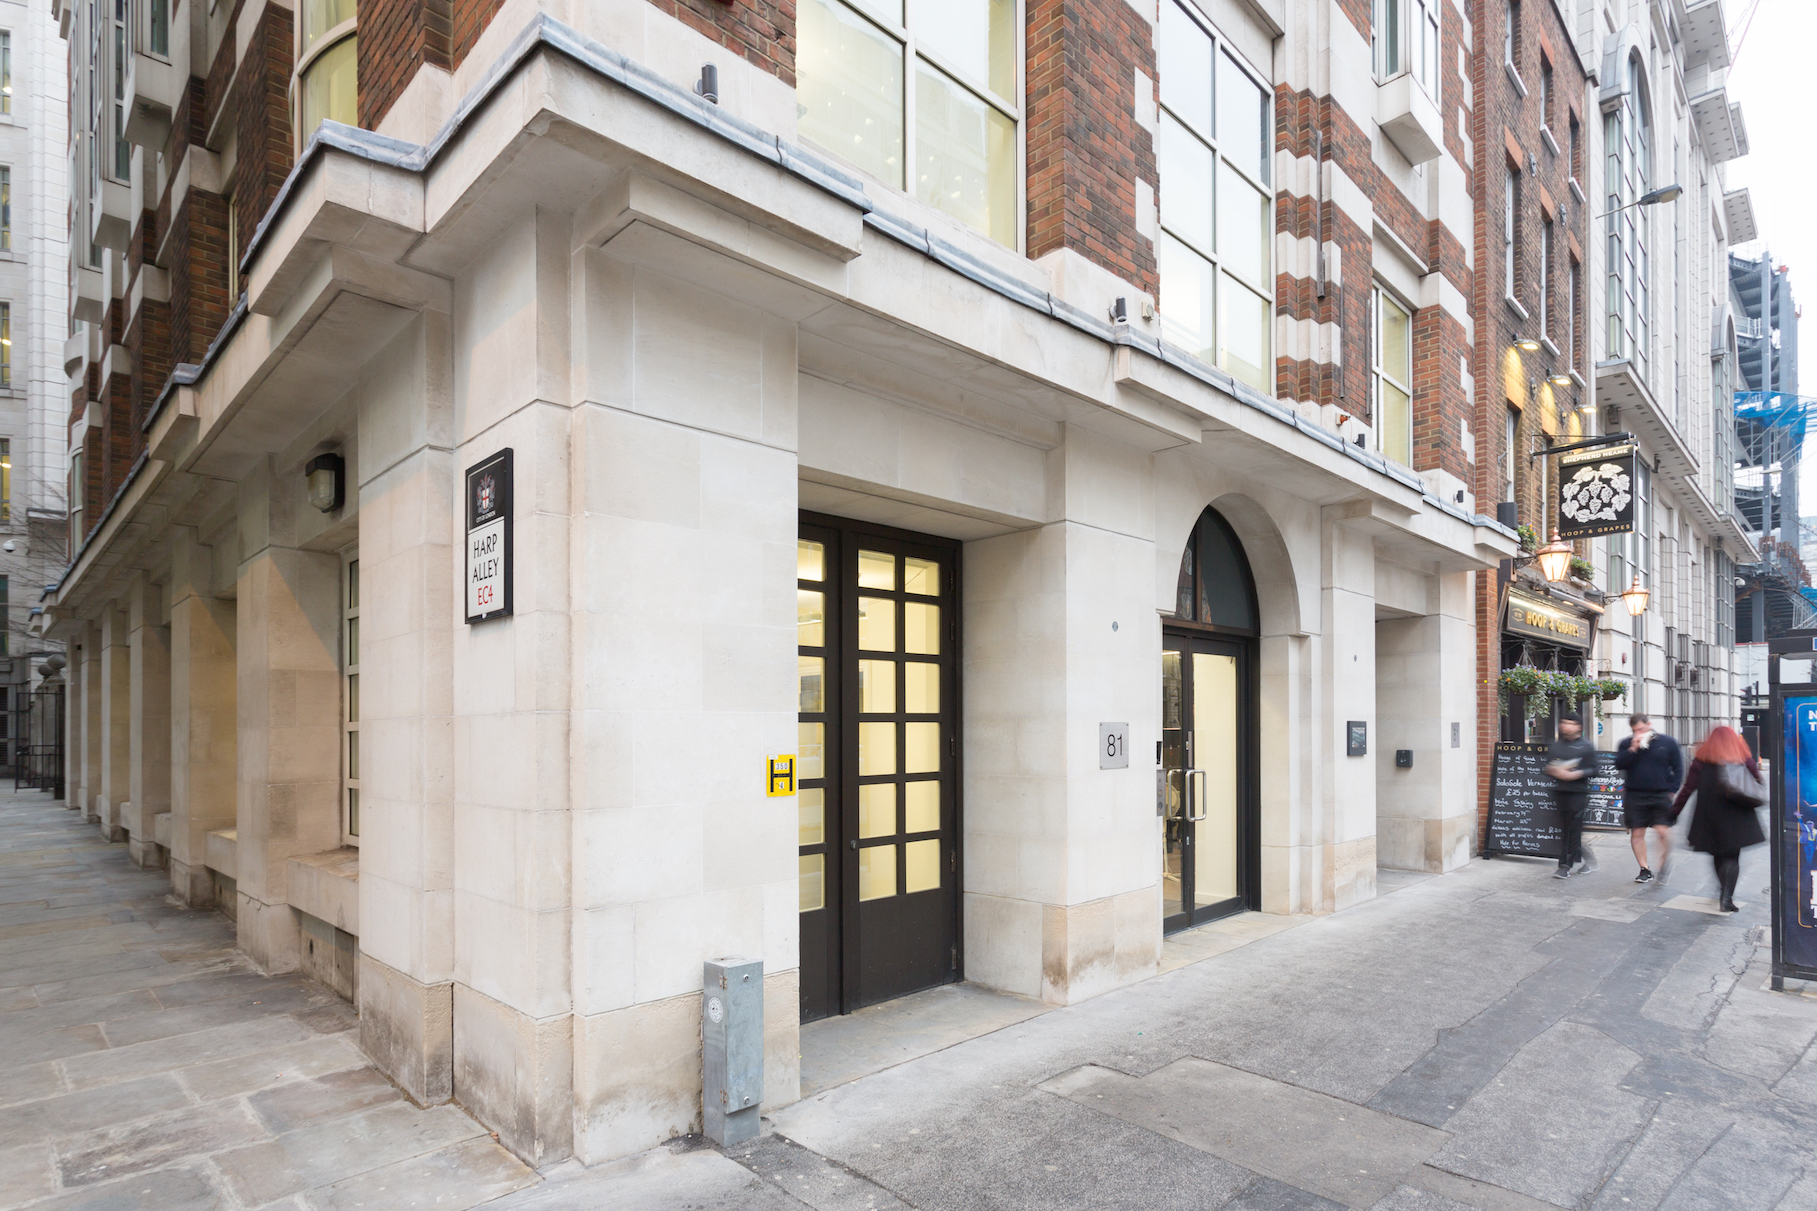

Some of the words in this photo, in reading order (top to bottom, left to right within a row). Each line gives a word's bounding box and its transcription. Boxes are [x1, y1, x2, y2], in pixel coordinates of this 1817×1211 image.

[1562, 454, 1602, 464] SHEPHERD
[1602, 448, 1629, 458] NEAME
[1597, 523, 1631, 533] GRAPES
[473, 533, 498, 559] HARP
[472, 557, 499, 583] ALLEY
[478, 585, 493, 606] EC4
[1525, 610, 1546, 629] HOOP
[1548, 618, 1555, 631] &
[1556, 619, 1580, 638] GRAPES
[1107, 733, 1123, 757] 81
[770, 759, 793, 793] H
